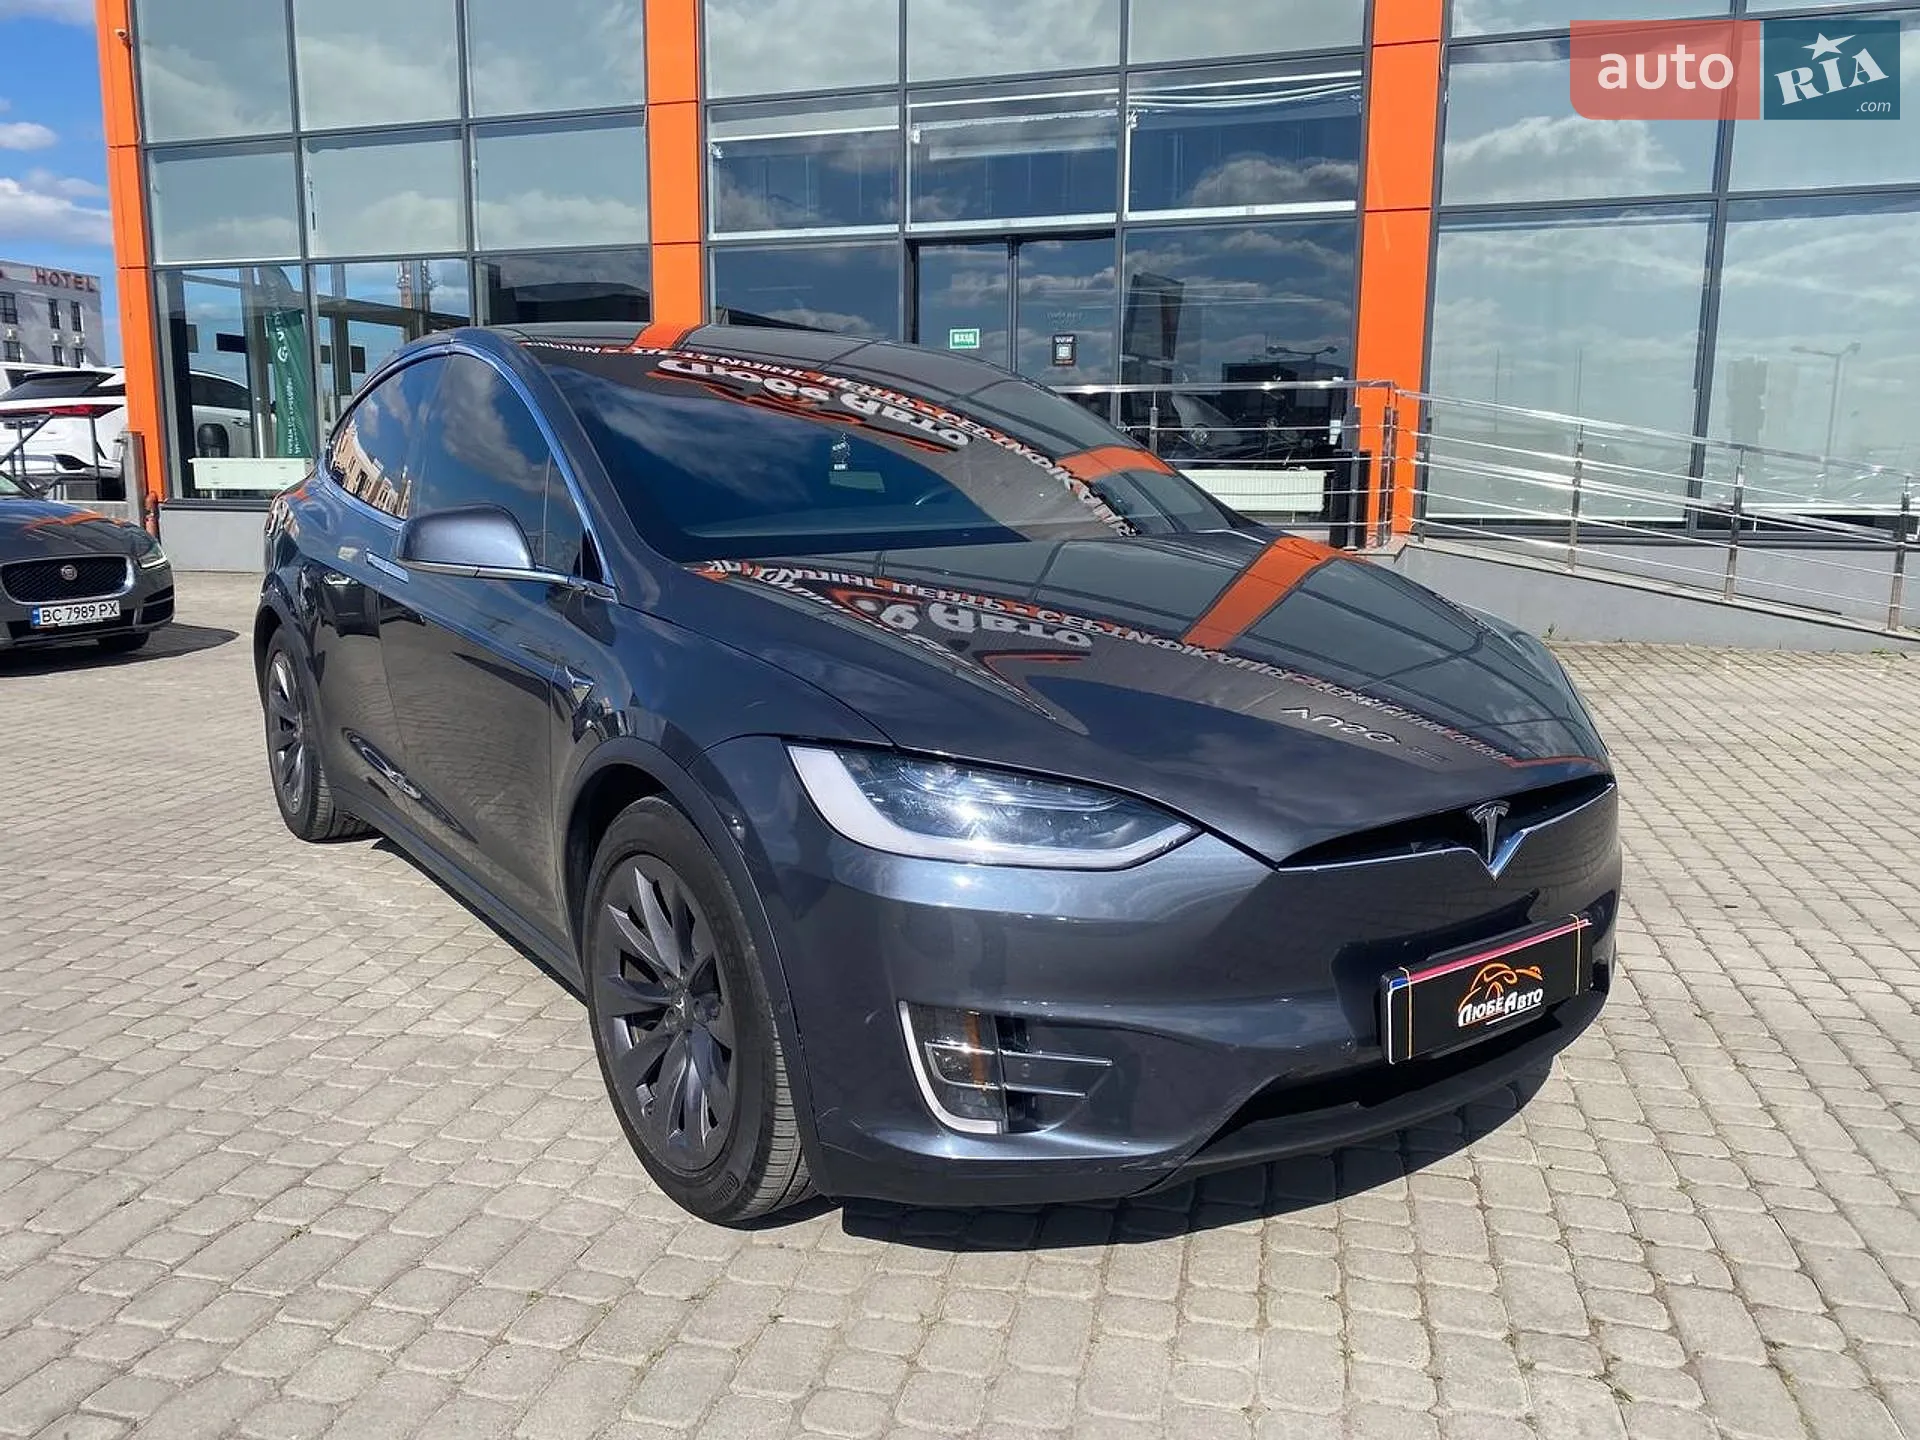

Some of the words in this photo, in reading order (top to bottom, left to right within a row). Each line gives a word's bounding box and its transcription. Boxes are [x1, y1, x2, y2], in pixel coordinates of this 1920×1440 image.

[35, 267, 97, 292] HOTEL
[42, 609, 62, 623] BC
[65, 604, 96, 620] 7989
[99, 601, 118, 617] PX
